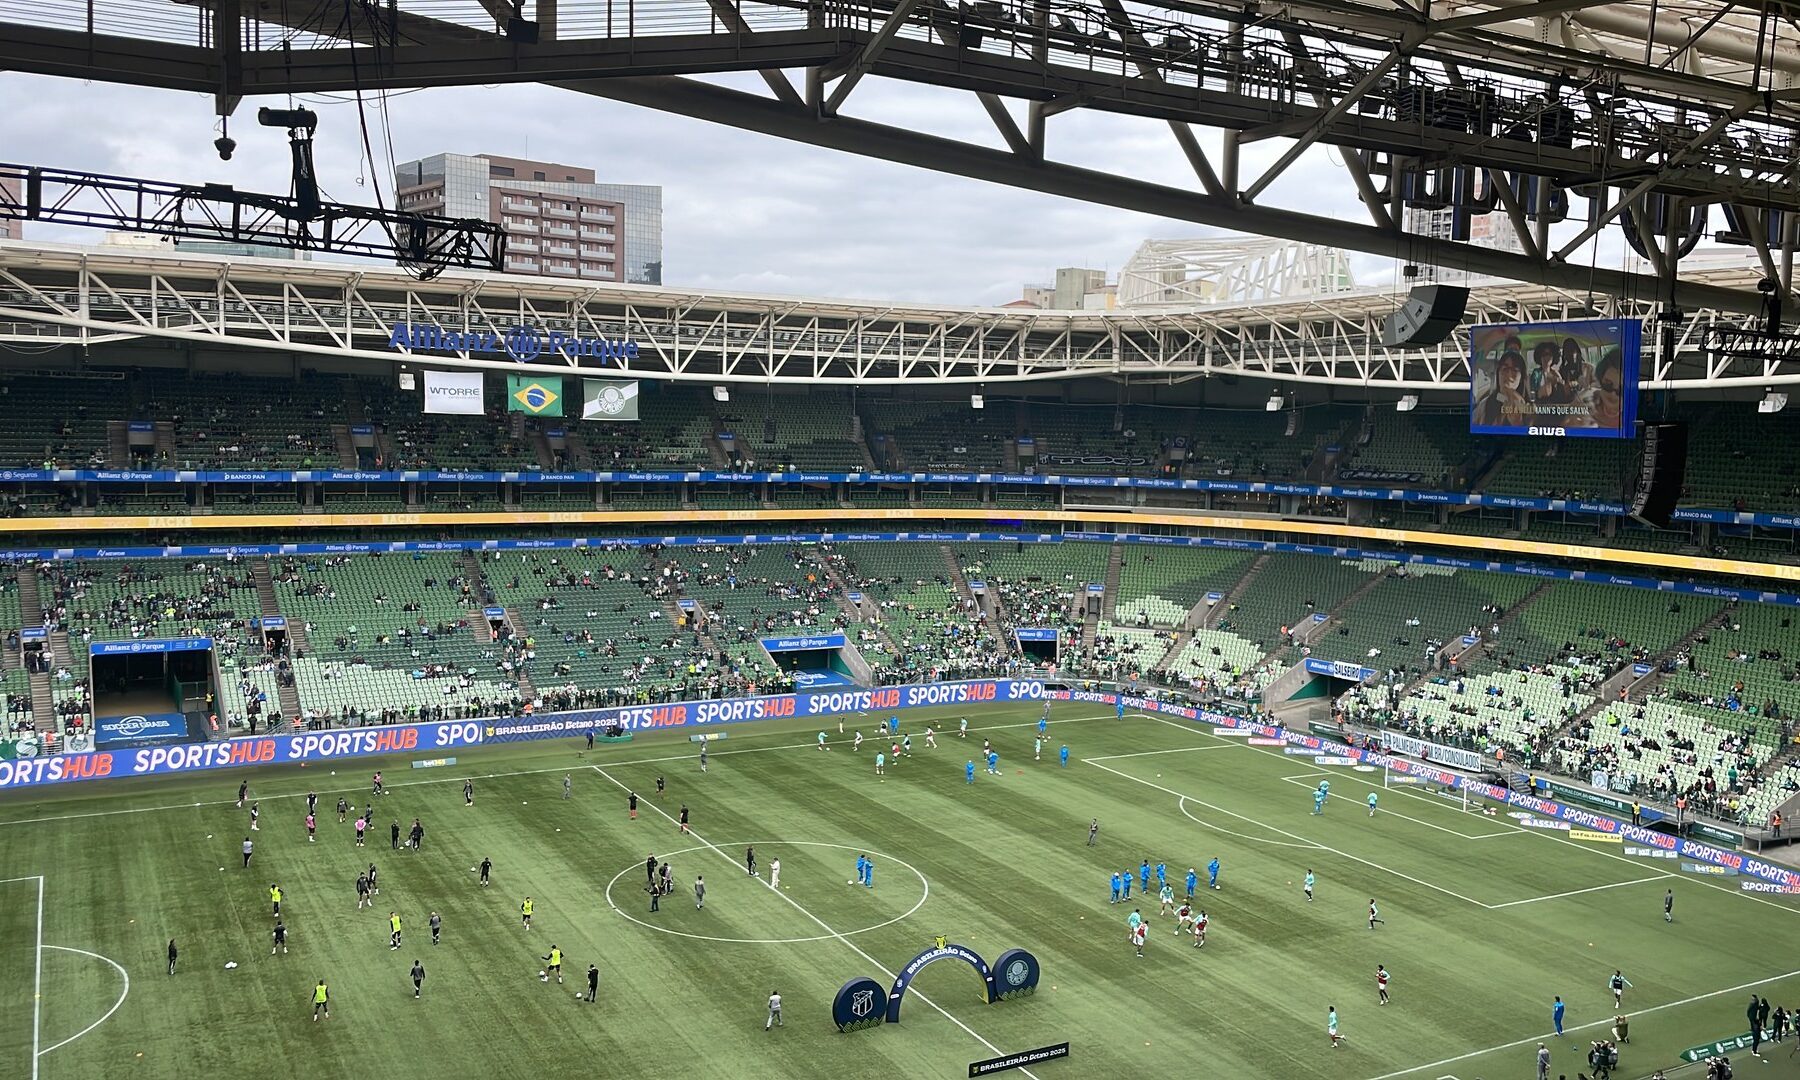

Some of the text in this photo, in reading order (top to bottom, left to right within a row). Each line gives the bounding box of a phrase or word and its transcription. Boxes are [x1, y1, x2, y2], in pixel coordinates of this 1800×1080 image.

[388, 323, 640, 365] Allianz Parque
[429, 386, 480, 396] WTORRE
[1557, 406, 1569, 415] QUE
[1570, 405, 1590, 415] SALVA
[1528, 426, 1566, 437] aiwa
[13, 471, 38, 480] Seguros
[131, 472, 152, 480] Parque
[1772, 516, 1793, 525] Allianz
[104, 643, 165, 651] Allianz Parque
[778, 639, 828, 648] Allianz Parque
[1310, 661, 1328, 670] Allianz
[1334, 663, 1360, 679] SALSEIRO
[907, 683, 997, 705] SPORTSHUB
[1008, 681, 1045, 699] SPO
[1073, 691, 1117, 704] SPORTSHUB
[695, 697, 796, 723] SPORTSHUB
[808, 689, 901, 714] SPORTSHUB
[1121, 697, 1159, 711] SPORTSHUB
[1160, 704, 1197, 719] SPORTSHUB
[1200, 711, 1237, 728] SPORTSHUB
[436, 722, 483, 746] SPO
[495, 718, 618, 736] BRASILEIRÃO Betano 2025
[1238, 719, 1276, 737] SPORTSHUB
[288, 728, 418, 759] SPORTSHUB
[1279, 729, 1320, 749] SPORTSHUB
[133, 739, 276, 771] SPORTSHUB
[1321, 740, 1362, 760] SPORTSHUB
[1365, 752, 1409, 772] SPORTSHUB
[1410, 764, 1456, 785] SPORTSHUB
[1459, 778, 1507, 800] SPORTSHUB
[1508, 791, 1558, 815] SPORTSHUB
[1562, 807, 1616, 833] SPORTSHUB
[1618, 823, 1677, 850] SPORTSHUB
[1681, 840, 1743, 869] SPORTSHUB
[1694, 863, 1725, 875] bet365
[906, 946, 978, 975] BRASILEIRÃO Betano
[980, 1047, 1066, 1072] BRASILEIRÃO Betano 2025
